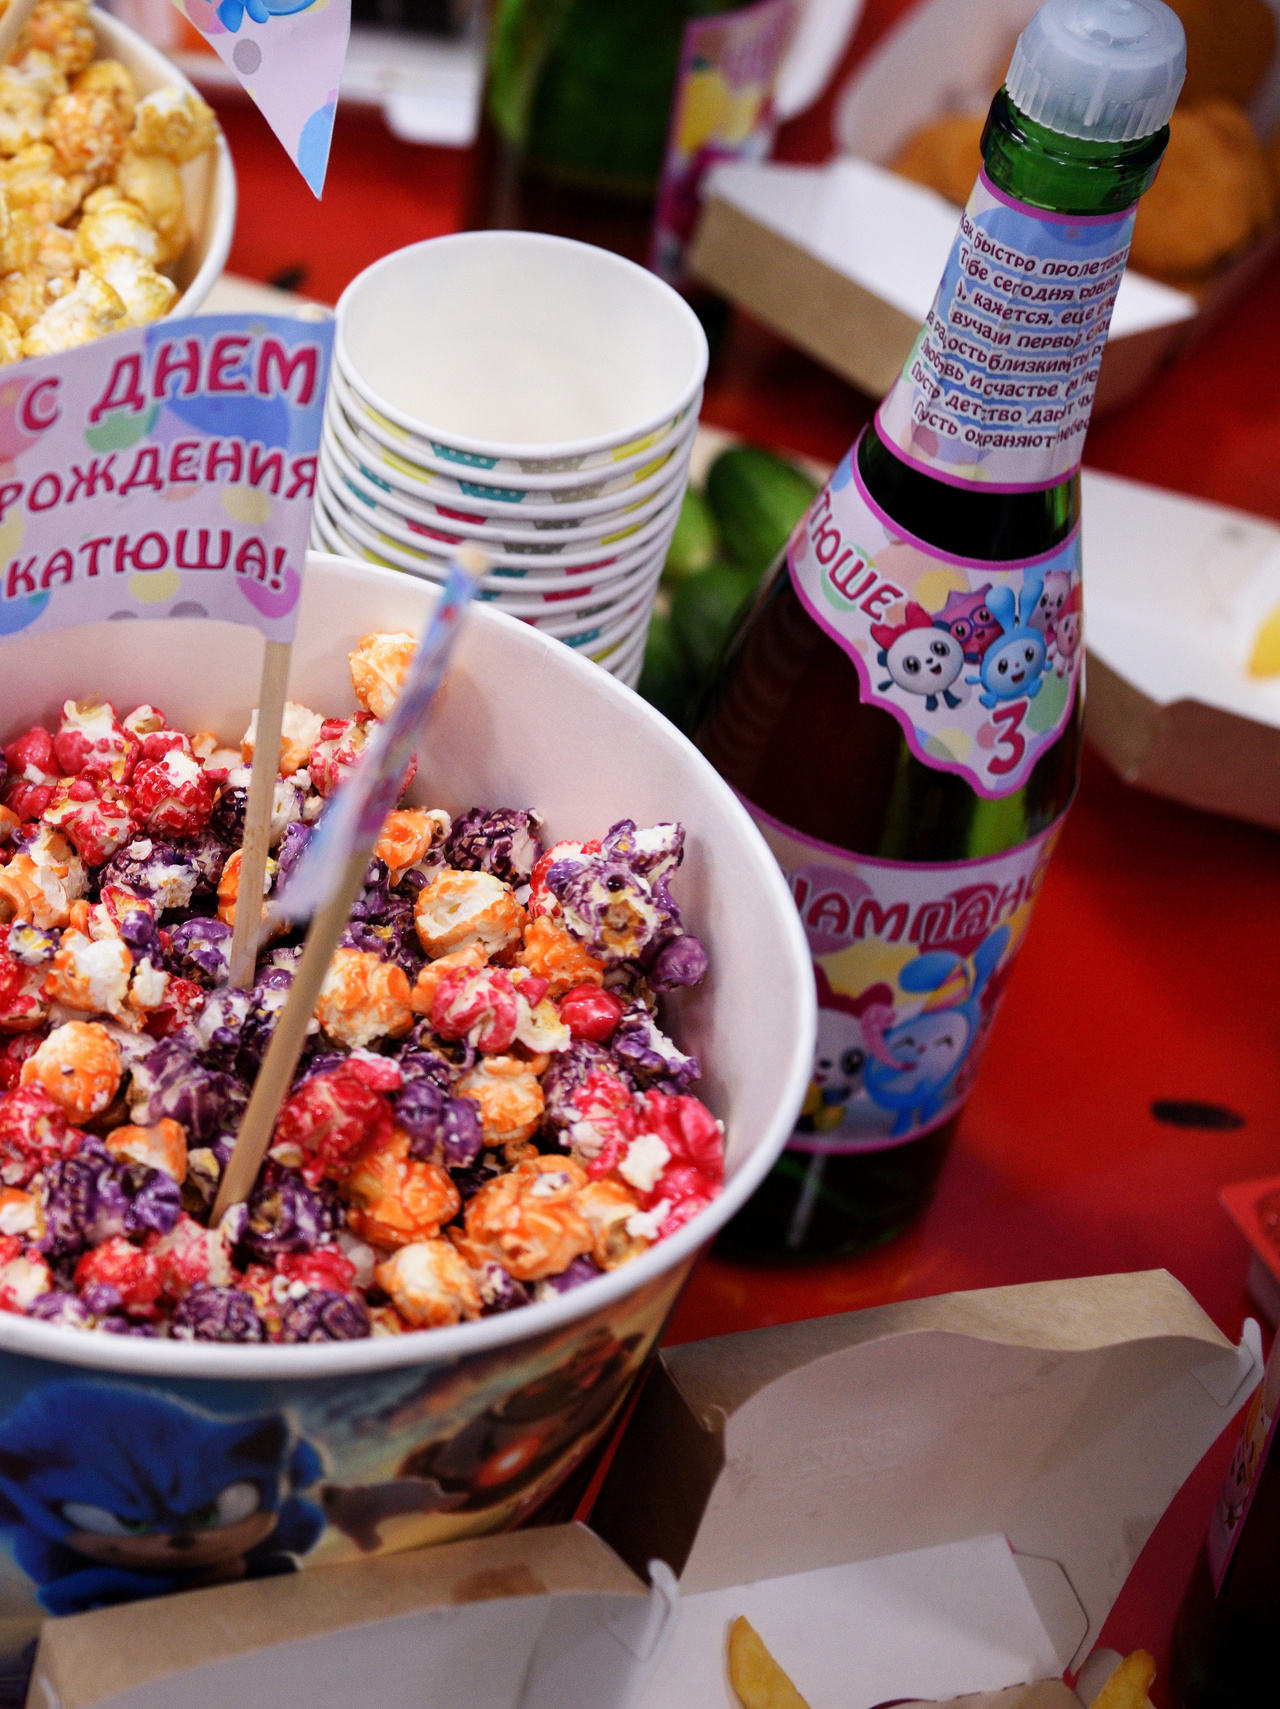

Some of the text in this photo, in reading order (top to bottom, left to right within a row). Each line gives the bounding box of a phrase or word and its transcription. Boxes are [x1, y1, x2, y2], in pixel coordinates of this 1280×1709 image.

[973, 232, 1035, 272] быстро
[1041, 247, 1130, 279] пролетают
[993, 274, 1075, 302] сегодня
[21, 336, 319, 431] С ДНЕМ
[969, 373, 984, 390] и
[983, 380, 1059, 398] счастье
[914, 399, 958, 436] Пусть
[5, 528, 288, 599] КАТЮША!
[987, 700, 1029, 775] 3
